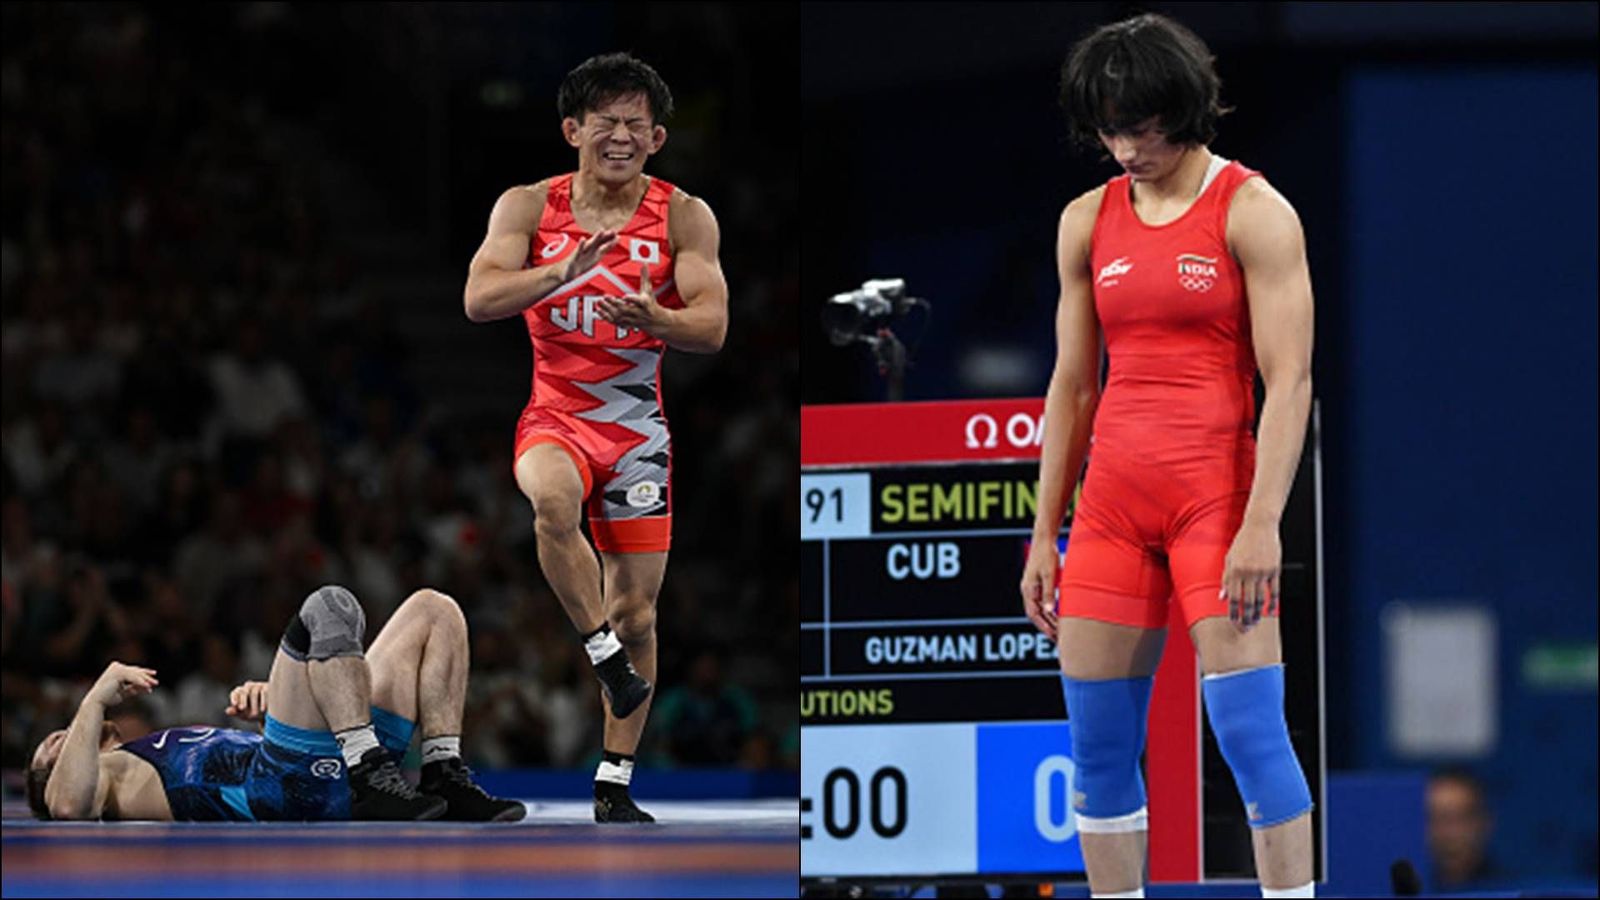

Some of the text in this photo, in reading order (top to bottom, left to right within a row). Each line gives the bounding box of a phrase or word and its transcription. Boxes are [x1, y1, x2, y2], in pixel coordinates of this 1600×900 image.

[1177, 262, 1219, 278] INDIA
[551, 295, 640, 339] JP
[805, 488, 844, 523] 91
[881, 480, 1081, 523] SEMIFIN
[887, 542, 960, 579] CUB
[865, 634, 977, 664] GUZMAN
[1034, 755, 1078, 842] 0
